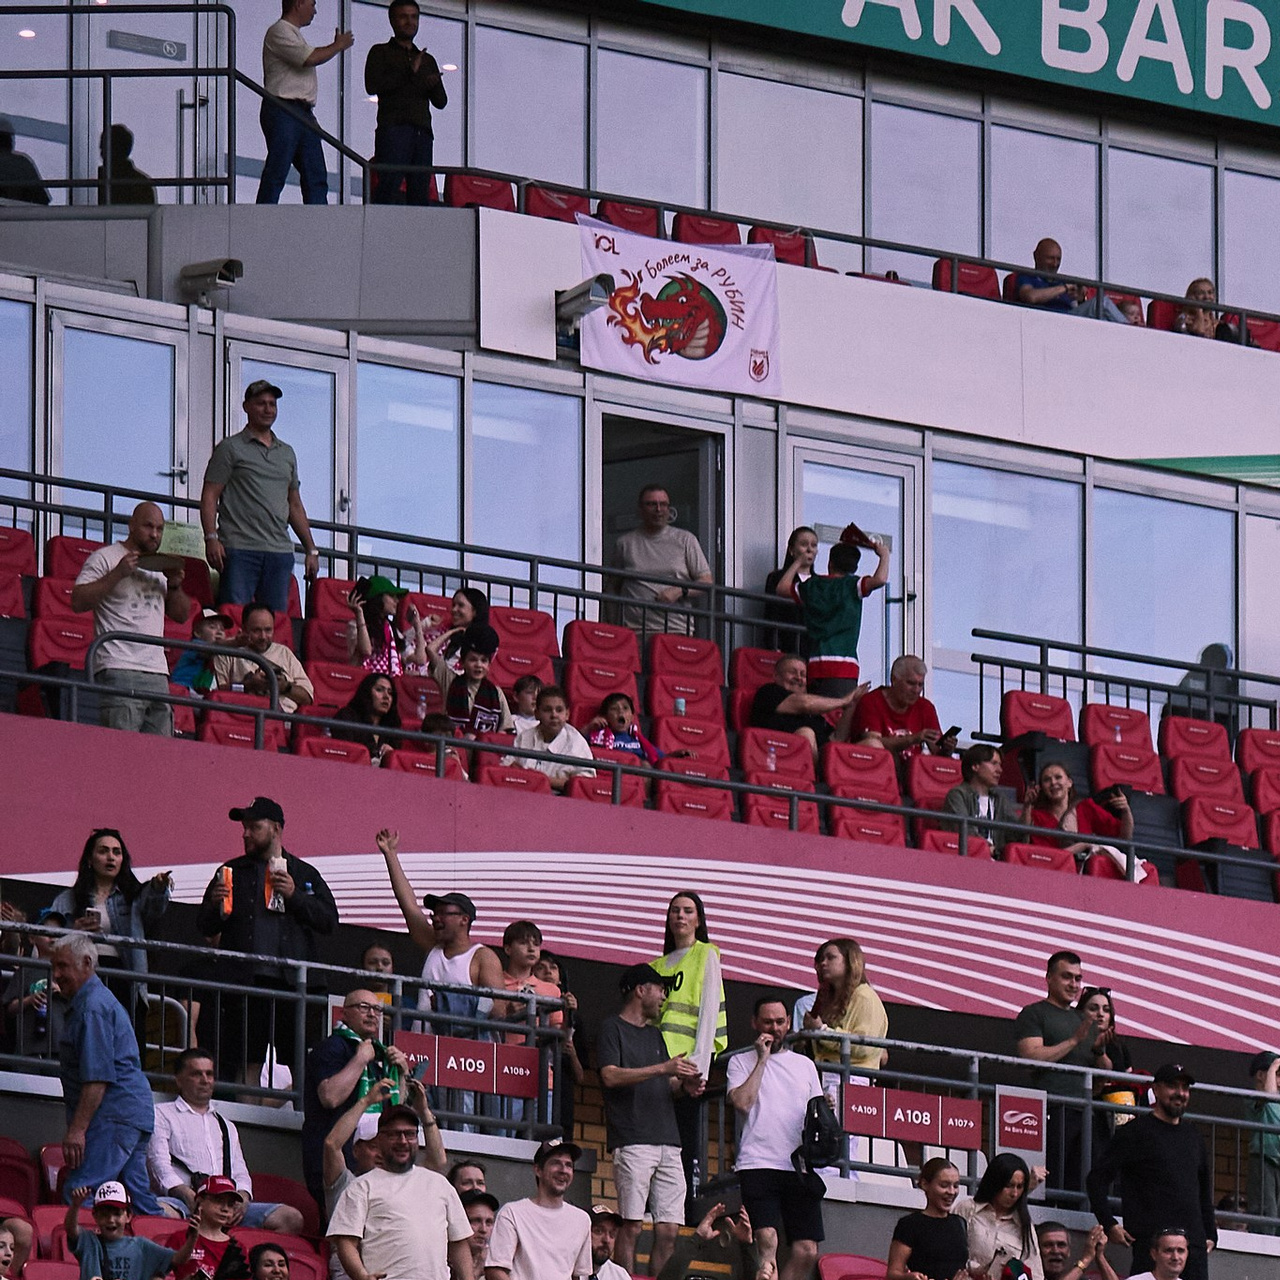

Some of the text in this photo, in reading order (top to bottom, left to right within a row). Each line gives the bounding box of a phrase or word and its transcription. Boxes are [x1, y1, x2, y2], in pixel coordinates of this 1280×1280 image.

[646, 253, 746, 332] Болеем за РУБИН
[446, 1056, 487, 1075] A109
[894, 1108, 932, 1127] A108
